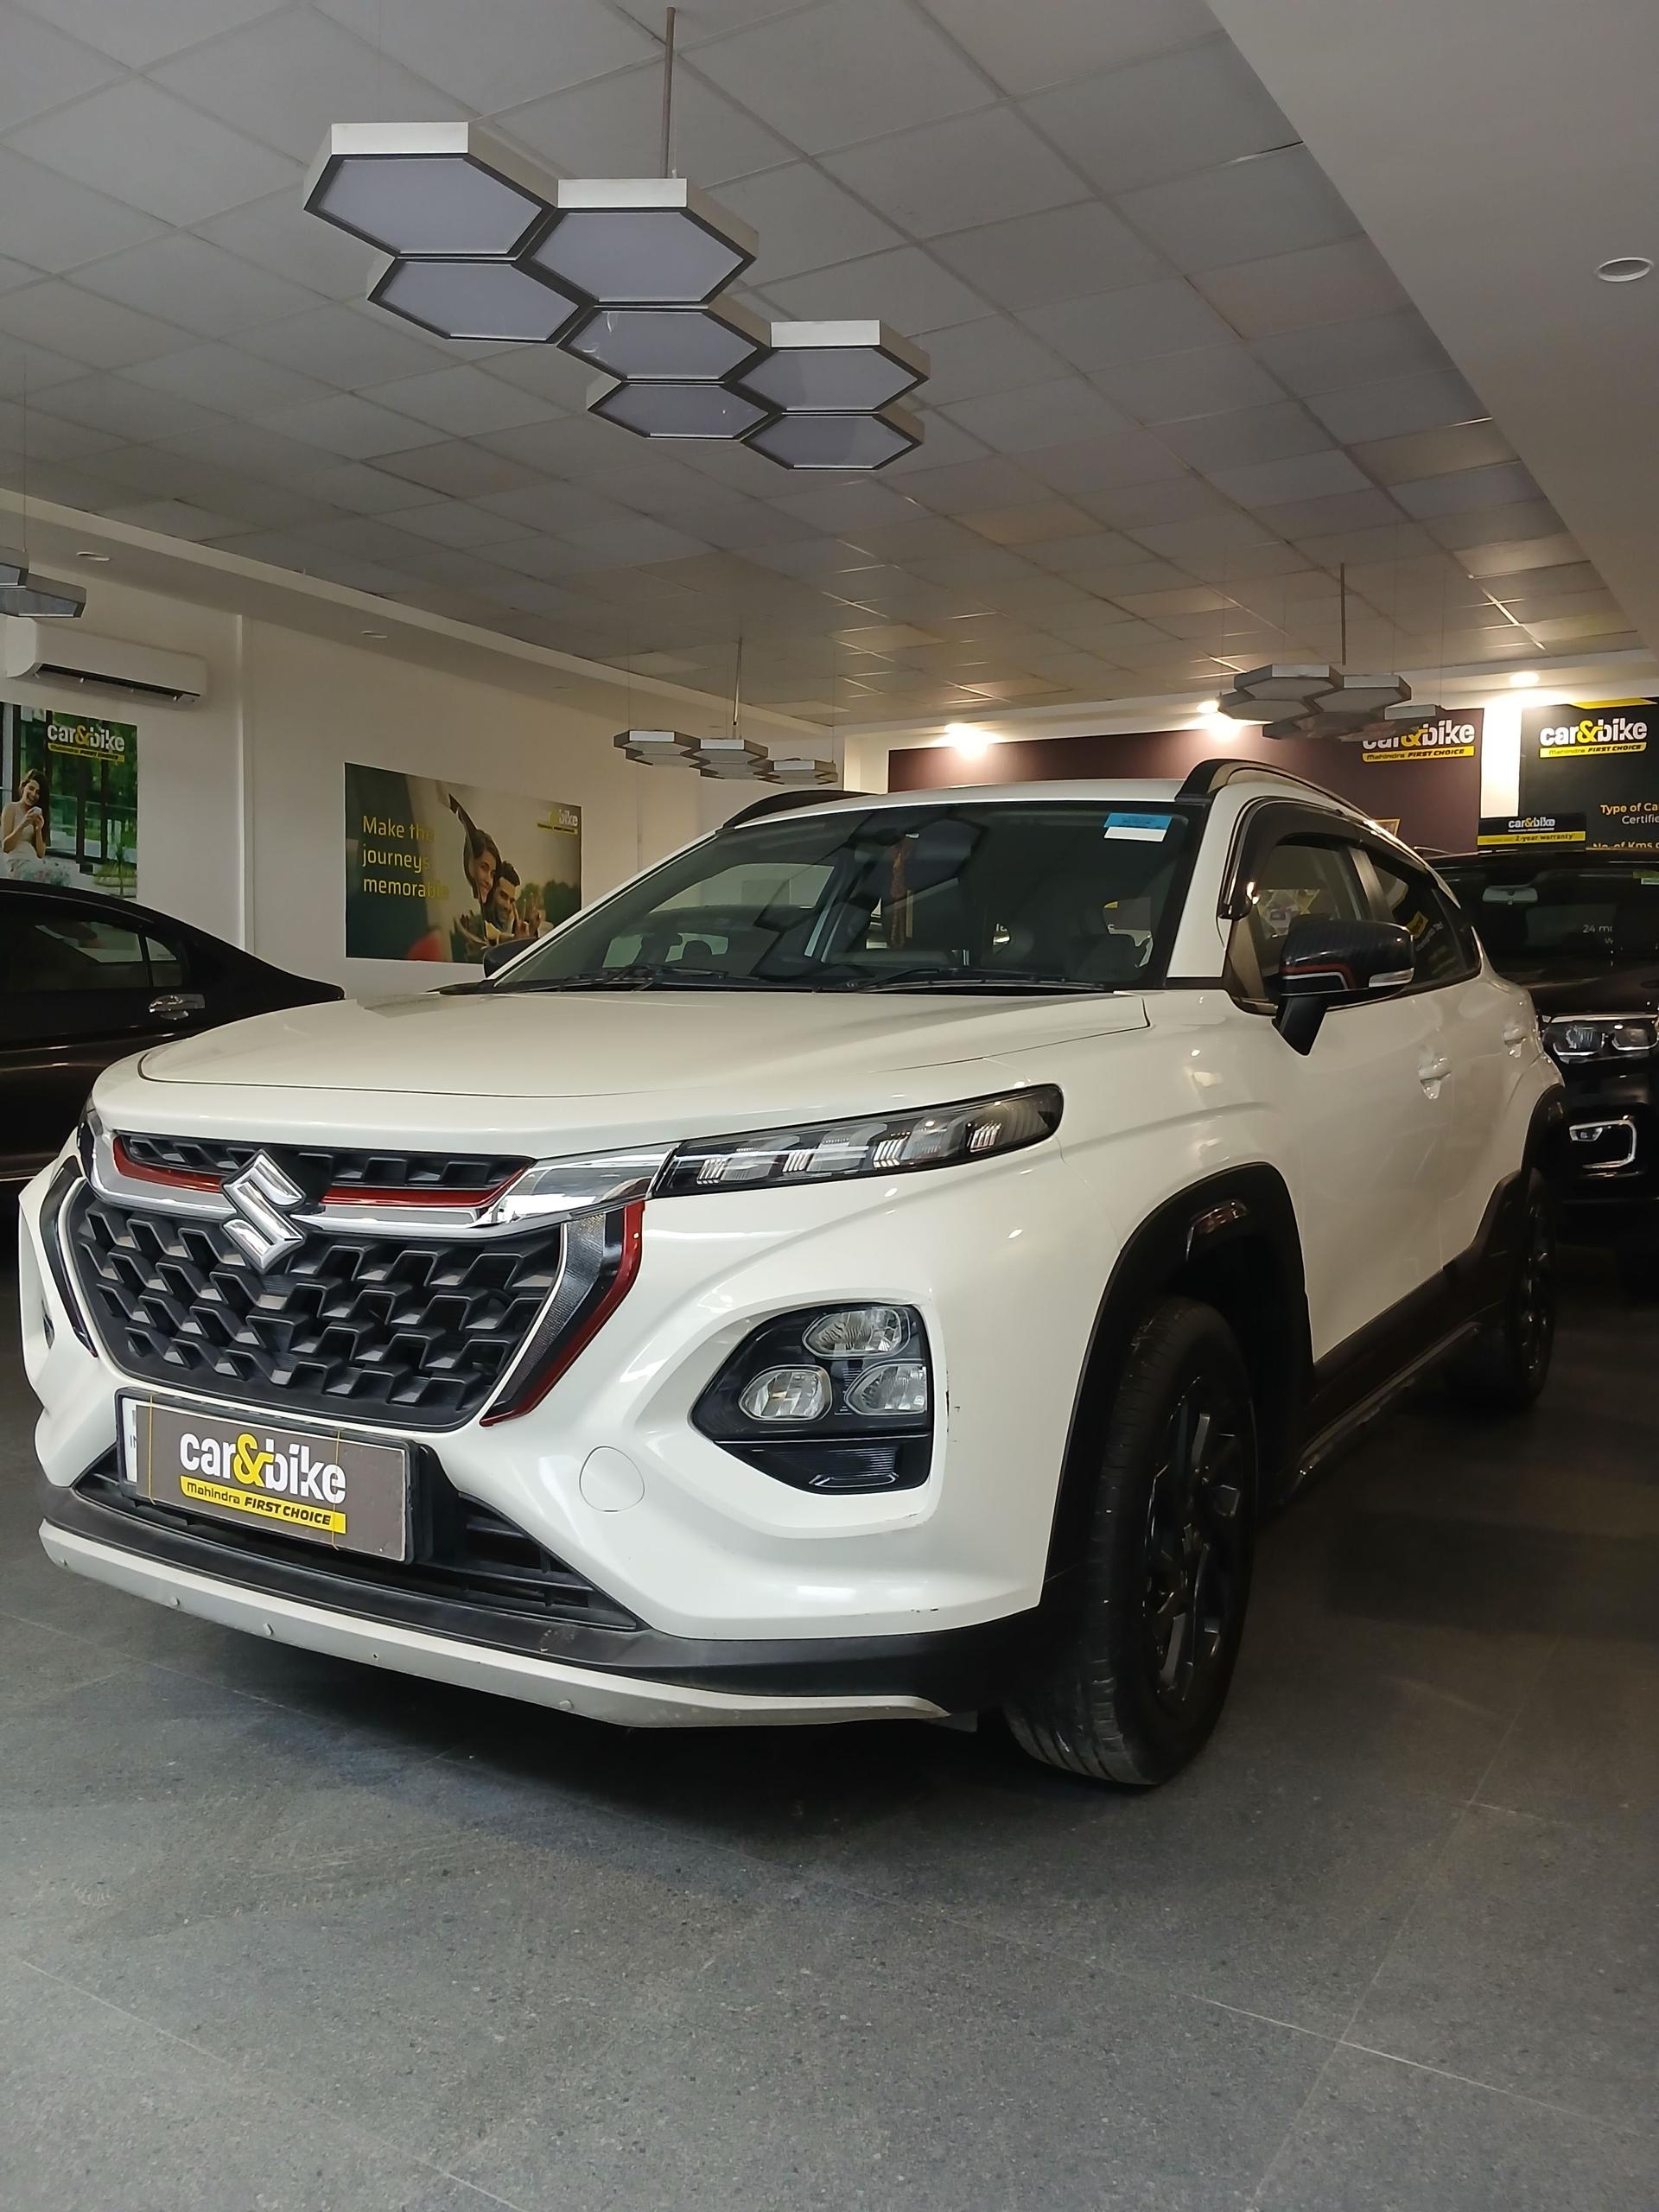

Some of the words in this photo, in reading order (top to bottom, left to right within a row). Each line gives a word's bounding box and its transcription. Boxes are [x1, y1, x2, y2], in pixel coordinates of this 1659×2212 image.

[48, 724, 125, 752] car&bike
[1540, 718, 1648, 747] car&bike
[1508, 817, 1555, 829] car&bike
[1600, 804, 1627, 815] Type
[1630, 803, 1642, 812] of
[363, 816, 405, 838] Make
[362, 843, 429, 874] journeys
[364, 879, 449, 900] memorable
[180, 1433, 346, 1503] car&bike
[187, 1482, 240, 1504] Mahindra
[245, 1497, 282, 1513] FIRST
[283, 1506, 332, 1526] CHOICE
